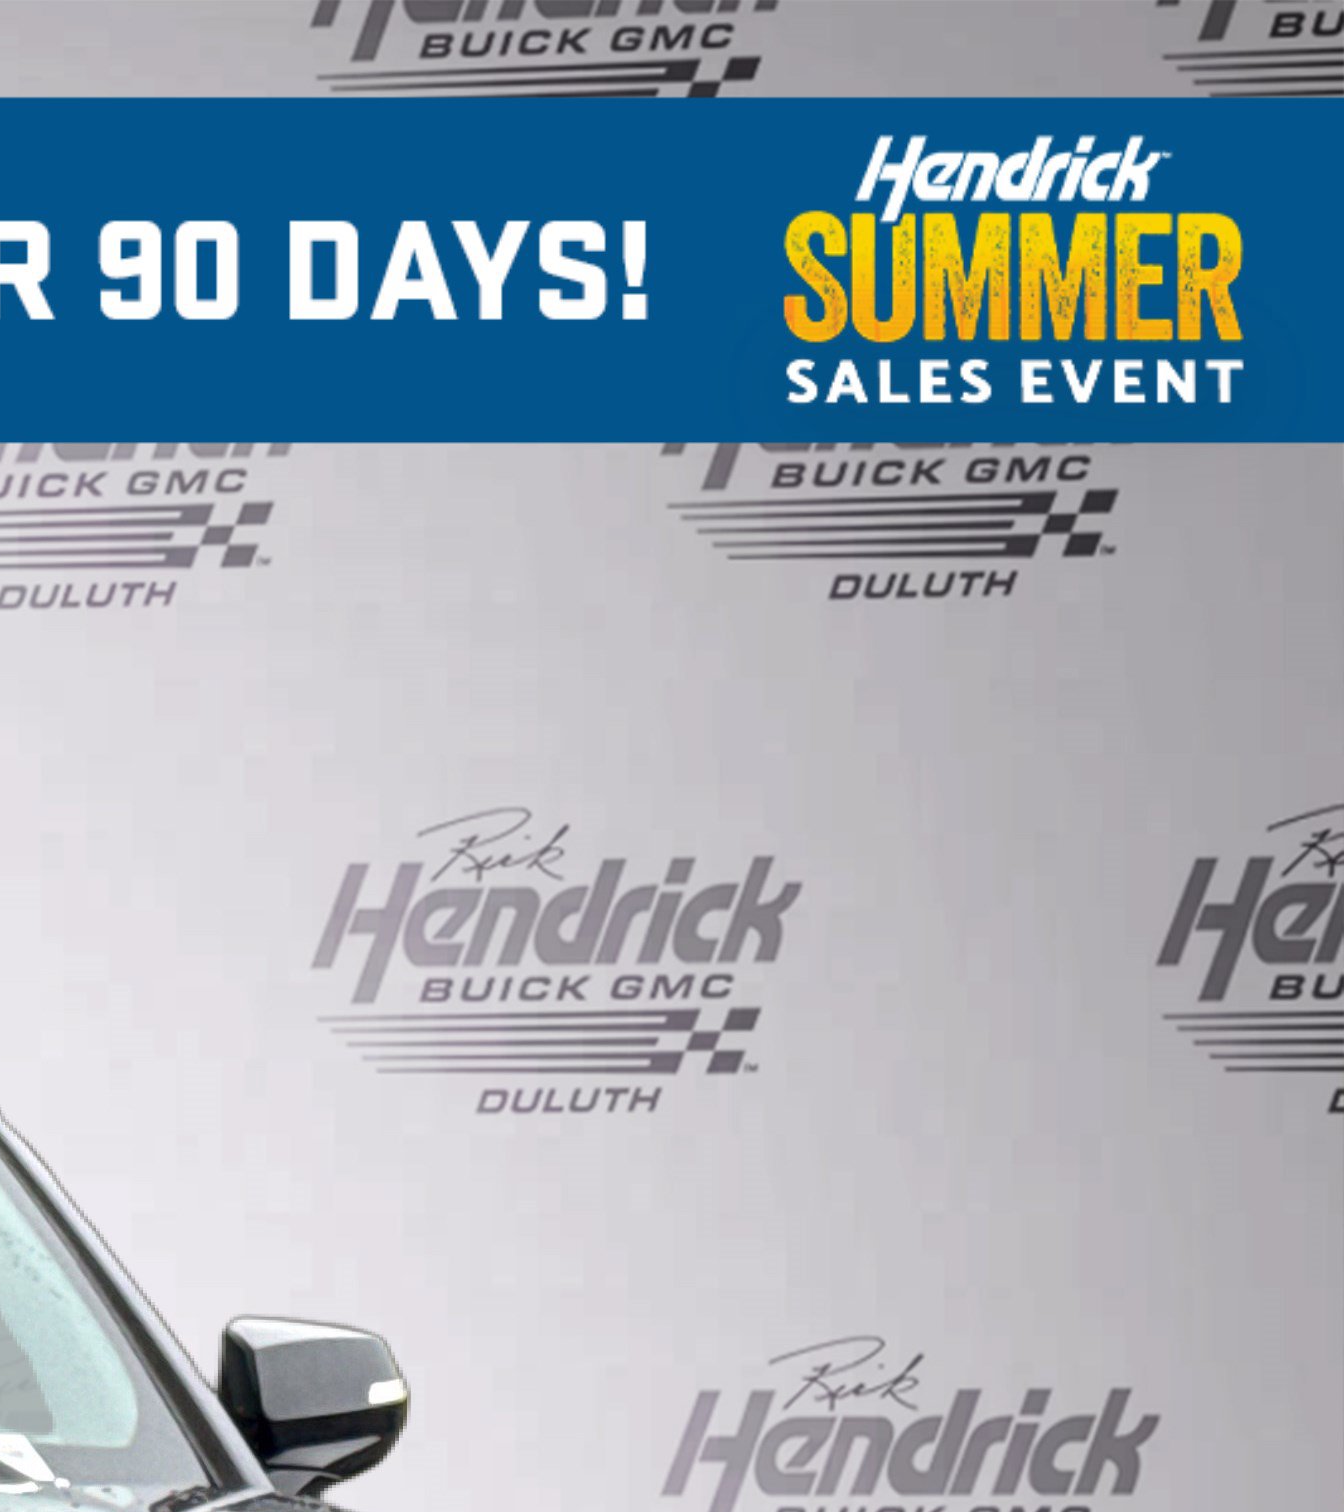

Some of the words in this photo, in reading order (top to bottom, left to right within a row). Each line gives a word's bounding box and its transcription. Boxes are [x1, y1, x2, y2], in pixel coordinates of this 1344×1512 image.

[419, 29, 591, 59] BUICK
[609, 24, 734, 52] GMC
[125, 468, 249, 497] GMC
[770, 459, 947, 489] BUICK
[965, 455, 1093, 484] GMC
[828, 571, 1017, 601] DULUTH
[311, 855, 803, 1004] Hendrick
[419, 976, 592, 1003] BUICK
[610, 973, 735, 1000] GMC
[476, 1087, 662, 1114] DULUTH
